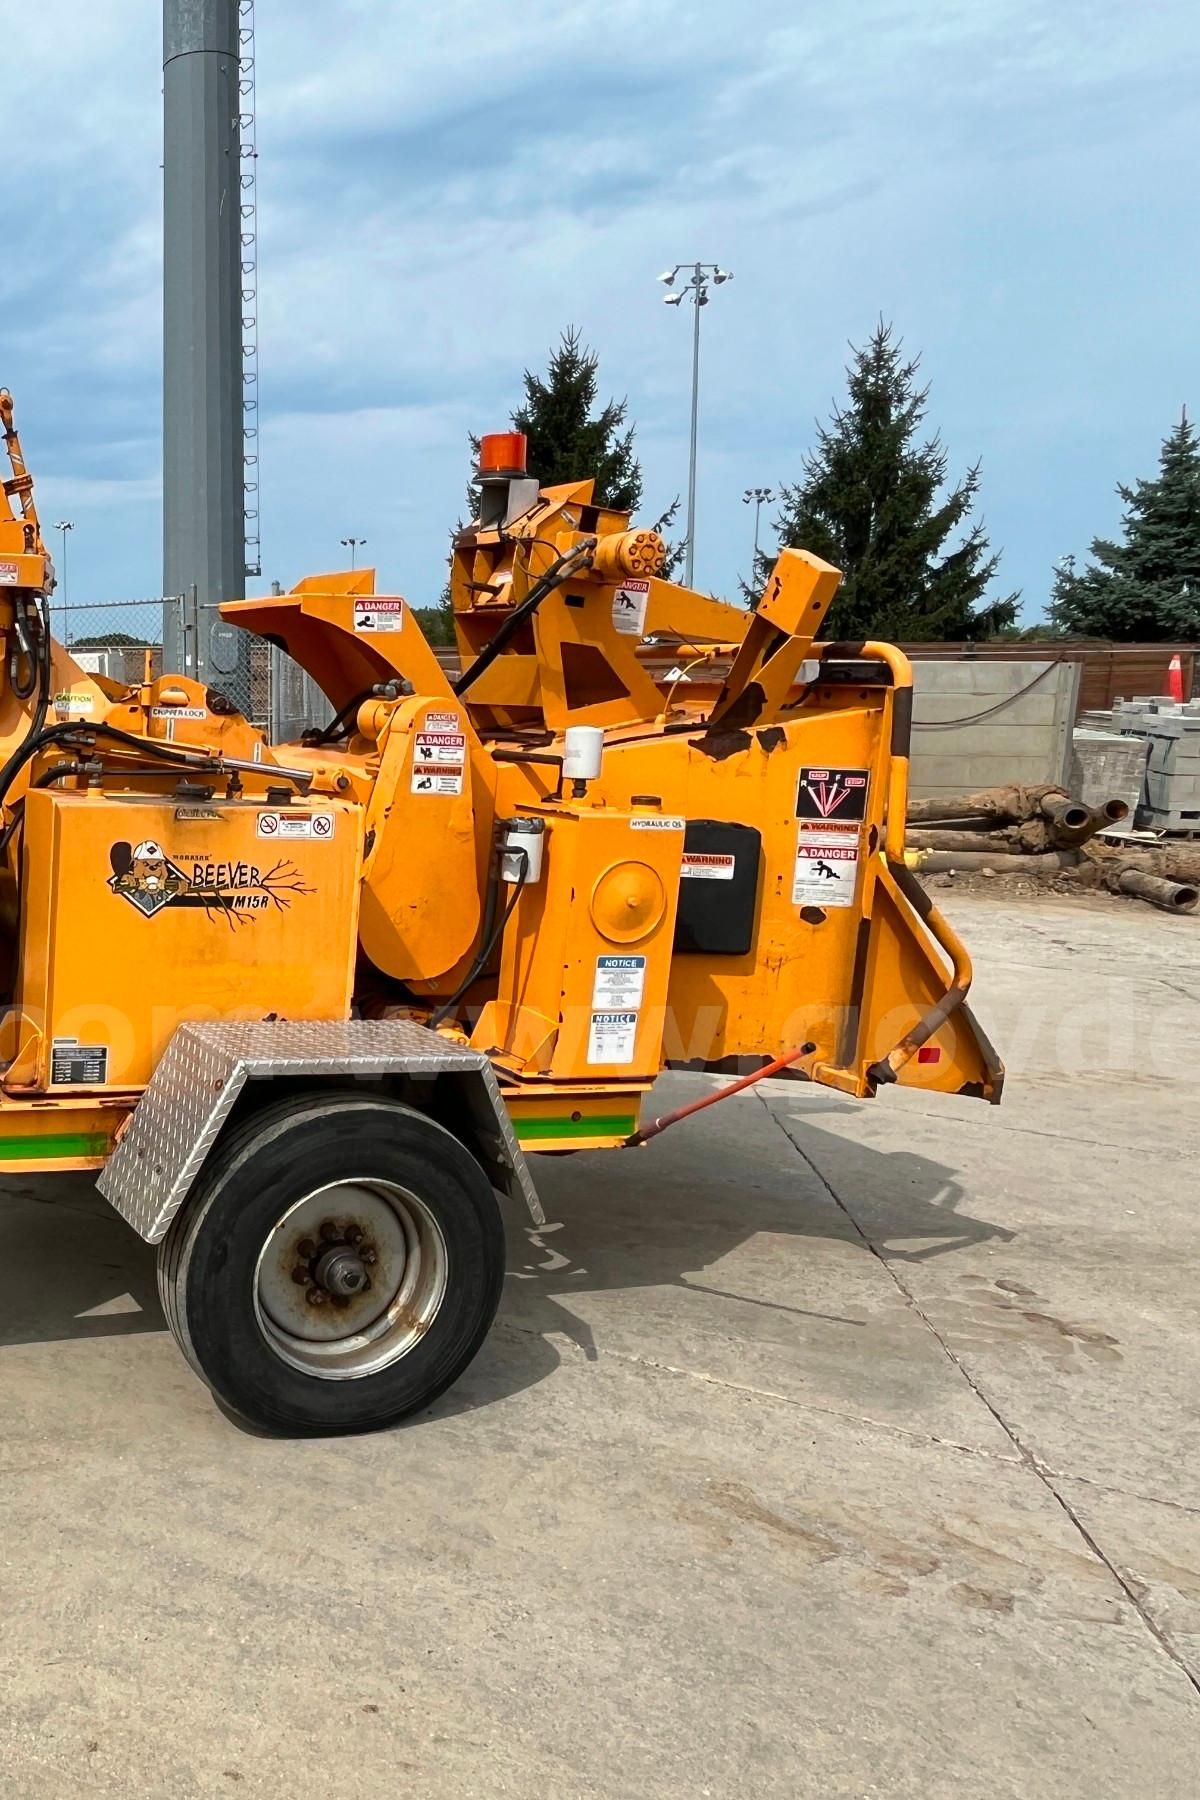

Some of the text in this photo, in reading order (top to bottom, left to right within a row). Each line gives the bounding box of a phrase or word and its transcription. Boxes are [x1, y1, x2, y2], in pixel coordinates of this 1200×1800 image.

[621, 581, 648, 591] ANGER
[364, 602, 400, 611] DANGER
[426, 736, 463, 746] DANGER
[800, 779, 808, 788] R
[632, 820, 670, 828] HYDRAULIC
[811, 823, 859, 832] WARNING
[809, 848, 856, 859] DANGER
[686, 855, 733, 865] WARNING
[192, 860, 264, 889] BEEVER
[232, 895, 269, 909] M15R
[604, 959, 638, 968] NOTICE
[595, 1014, 631, 1024] NOTICE
